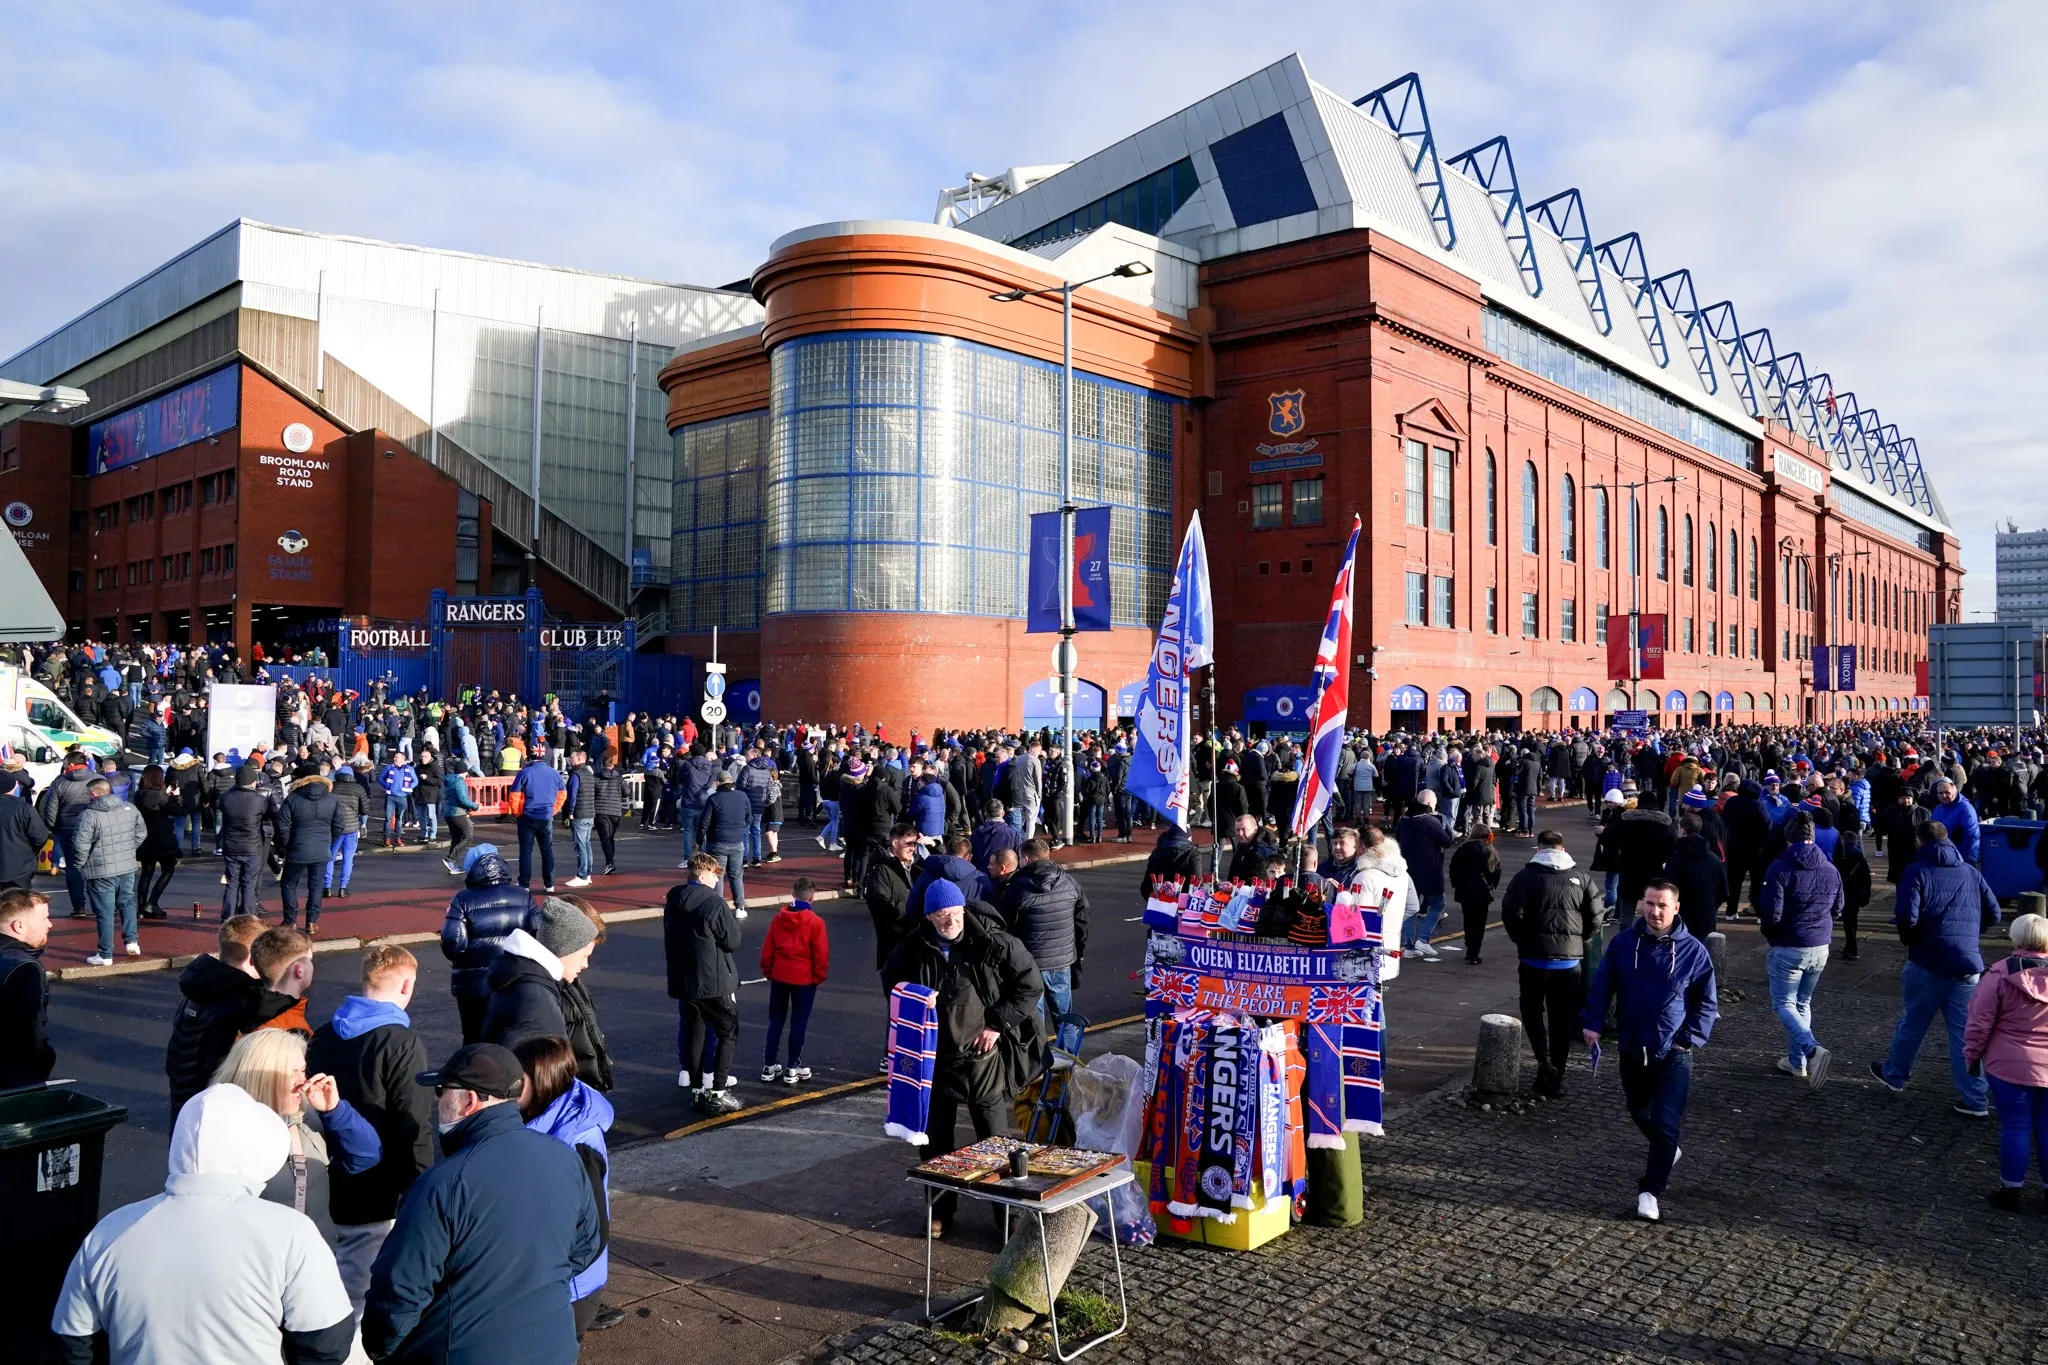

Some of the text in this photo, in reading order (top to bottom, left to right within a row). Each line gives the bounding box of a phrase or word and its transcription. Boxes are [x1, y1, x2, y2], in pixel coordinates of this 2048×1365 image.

[259, 456, 330, 471] BROOMLOAN
[1778, 453, 1806, 482] RANGERS
[279, 467, 311, 478] ROAD
[276, 477, 313, 488] STAND
[1090, 561, 1101, 571] 27
[446, 604, 526, 621] RANGERS
[351, 630, 431, 646] FOOTBALL
[540, 630, 586, 646] CLUB
[706, 706, 722, 716] 20
[1191, 946, 1326, 976] QUEEN ELIZABETH II
[1270, 975, 1279, 984] IN
[1223, 980, 1286, 1000] WE ARE
[1203, 991, 1303, 1016] THE PEOPLE
[1188, 1061, 1197, 1084] THE
[1183, 1085, 1194, 1135] PEOPLE
[1266, 1083, 1281, 1165] RANGERS
